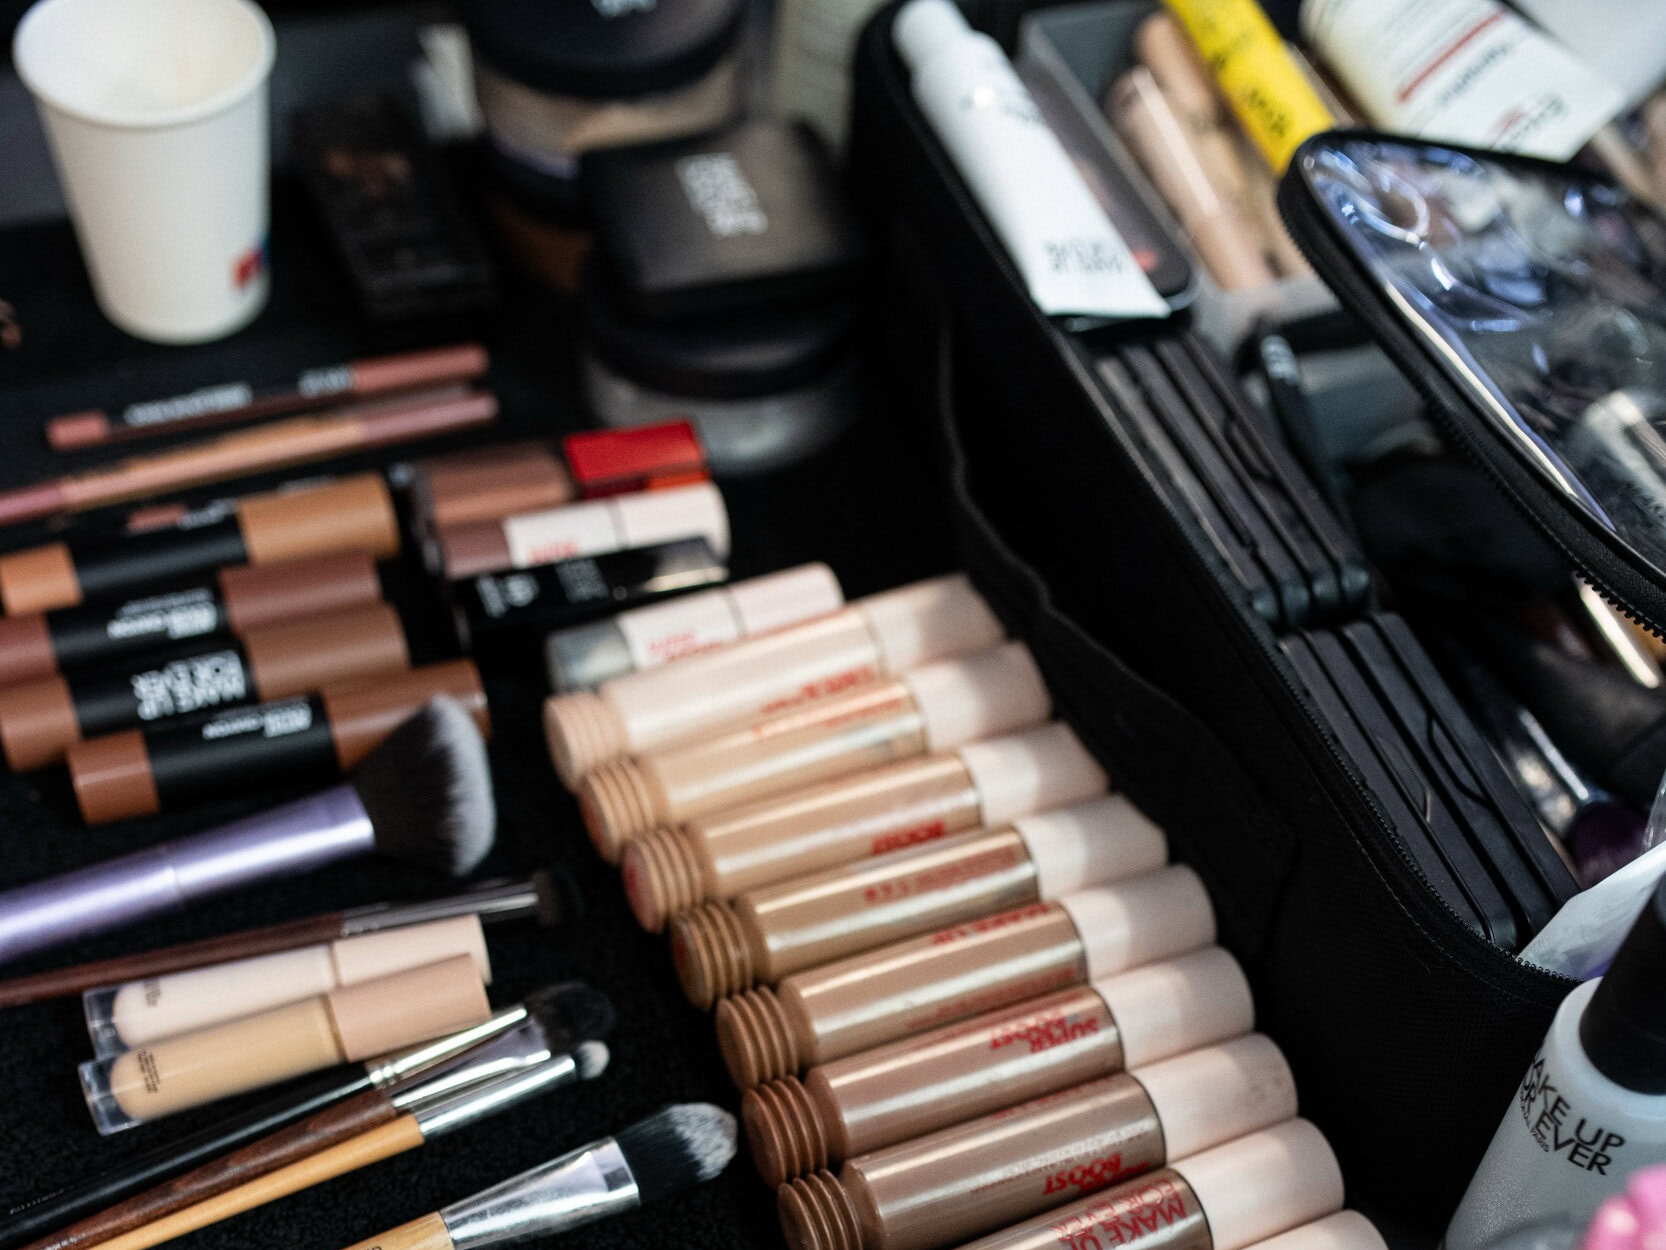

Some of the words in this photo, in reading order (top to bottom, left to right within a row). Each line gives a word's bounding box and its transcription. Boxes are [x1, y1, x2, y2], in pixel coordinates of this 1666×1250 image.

[1535, 1110, 1613, 1177] EVER
[1575, 1117, 1627, 1153] UP
[1042, 1152, 1122, 1196] BOOST
[1119, 1177, 1178, 1214] FOR
[1050, 1200, 1119, 1243] EVER
[1104, 1192, 1188, 1246] MAKE
